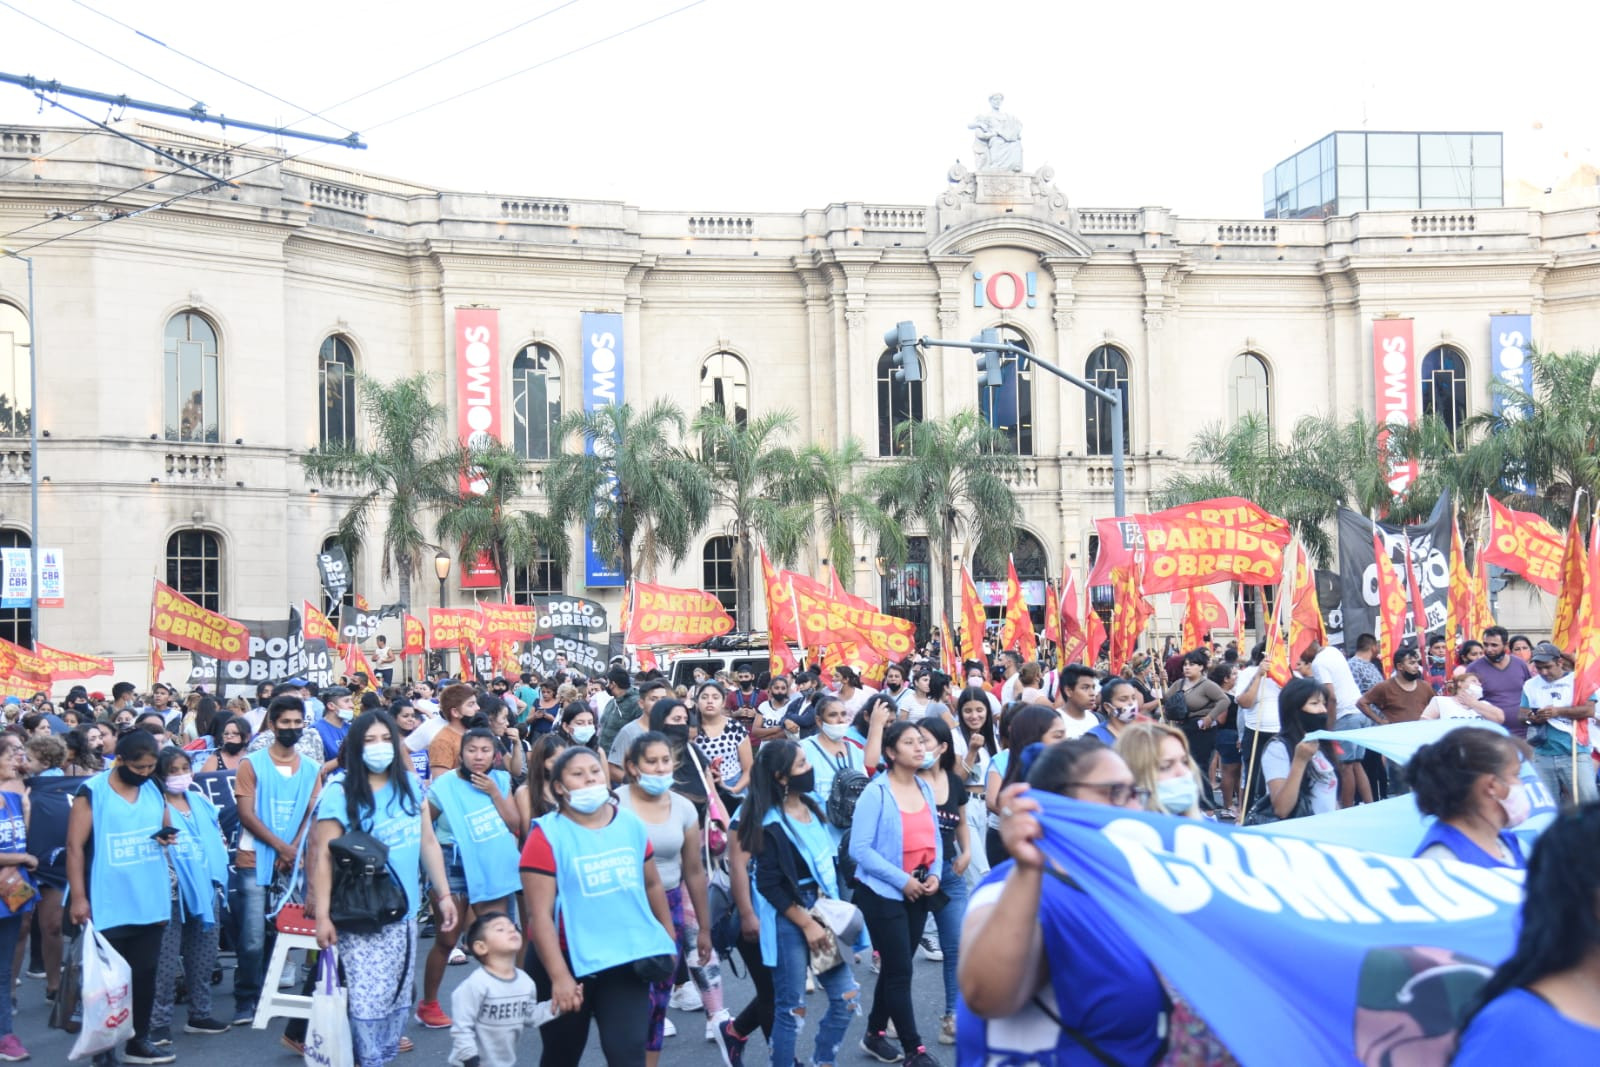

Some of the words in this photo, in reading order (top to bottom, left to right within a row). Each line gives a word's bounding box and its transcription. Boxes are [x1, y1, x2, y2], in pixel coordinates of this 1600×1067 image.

[1147, 527, 1282, 559] PARTIDO
[1153, 554, 1275, 578] OBRERO
[548, 602, 594, 616] POLO
[640, 591, 717, 612] PARTID
[539, 614, 604, 629] OBRERO
[640, 613, 731, 634] OBRERO
[156, 613, 241, 653] OBRERO
[249, 629, 304, 658] POLO
[554, 637, 599, 658] POLO
[542, 649, 606, 673] ORERO
[115, 847, 136, 858] DE
[587, 871, 612, 887] DE
